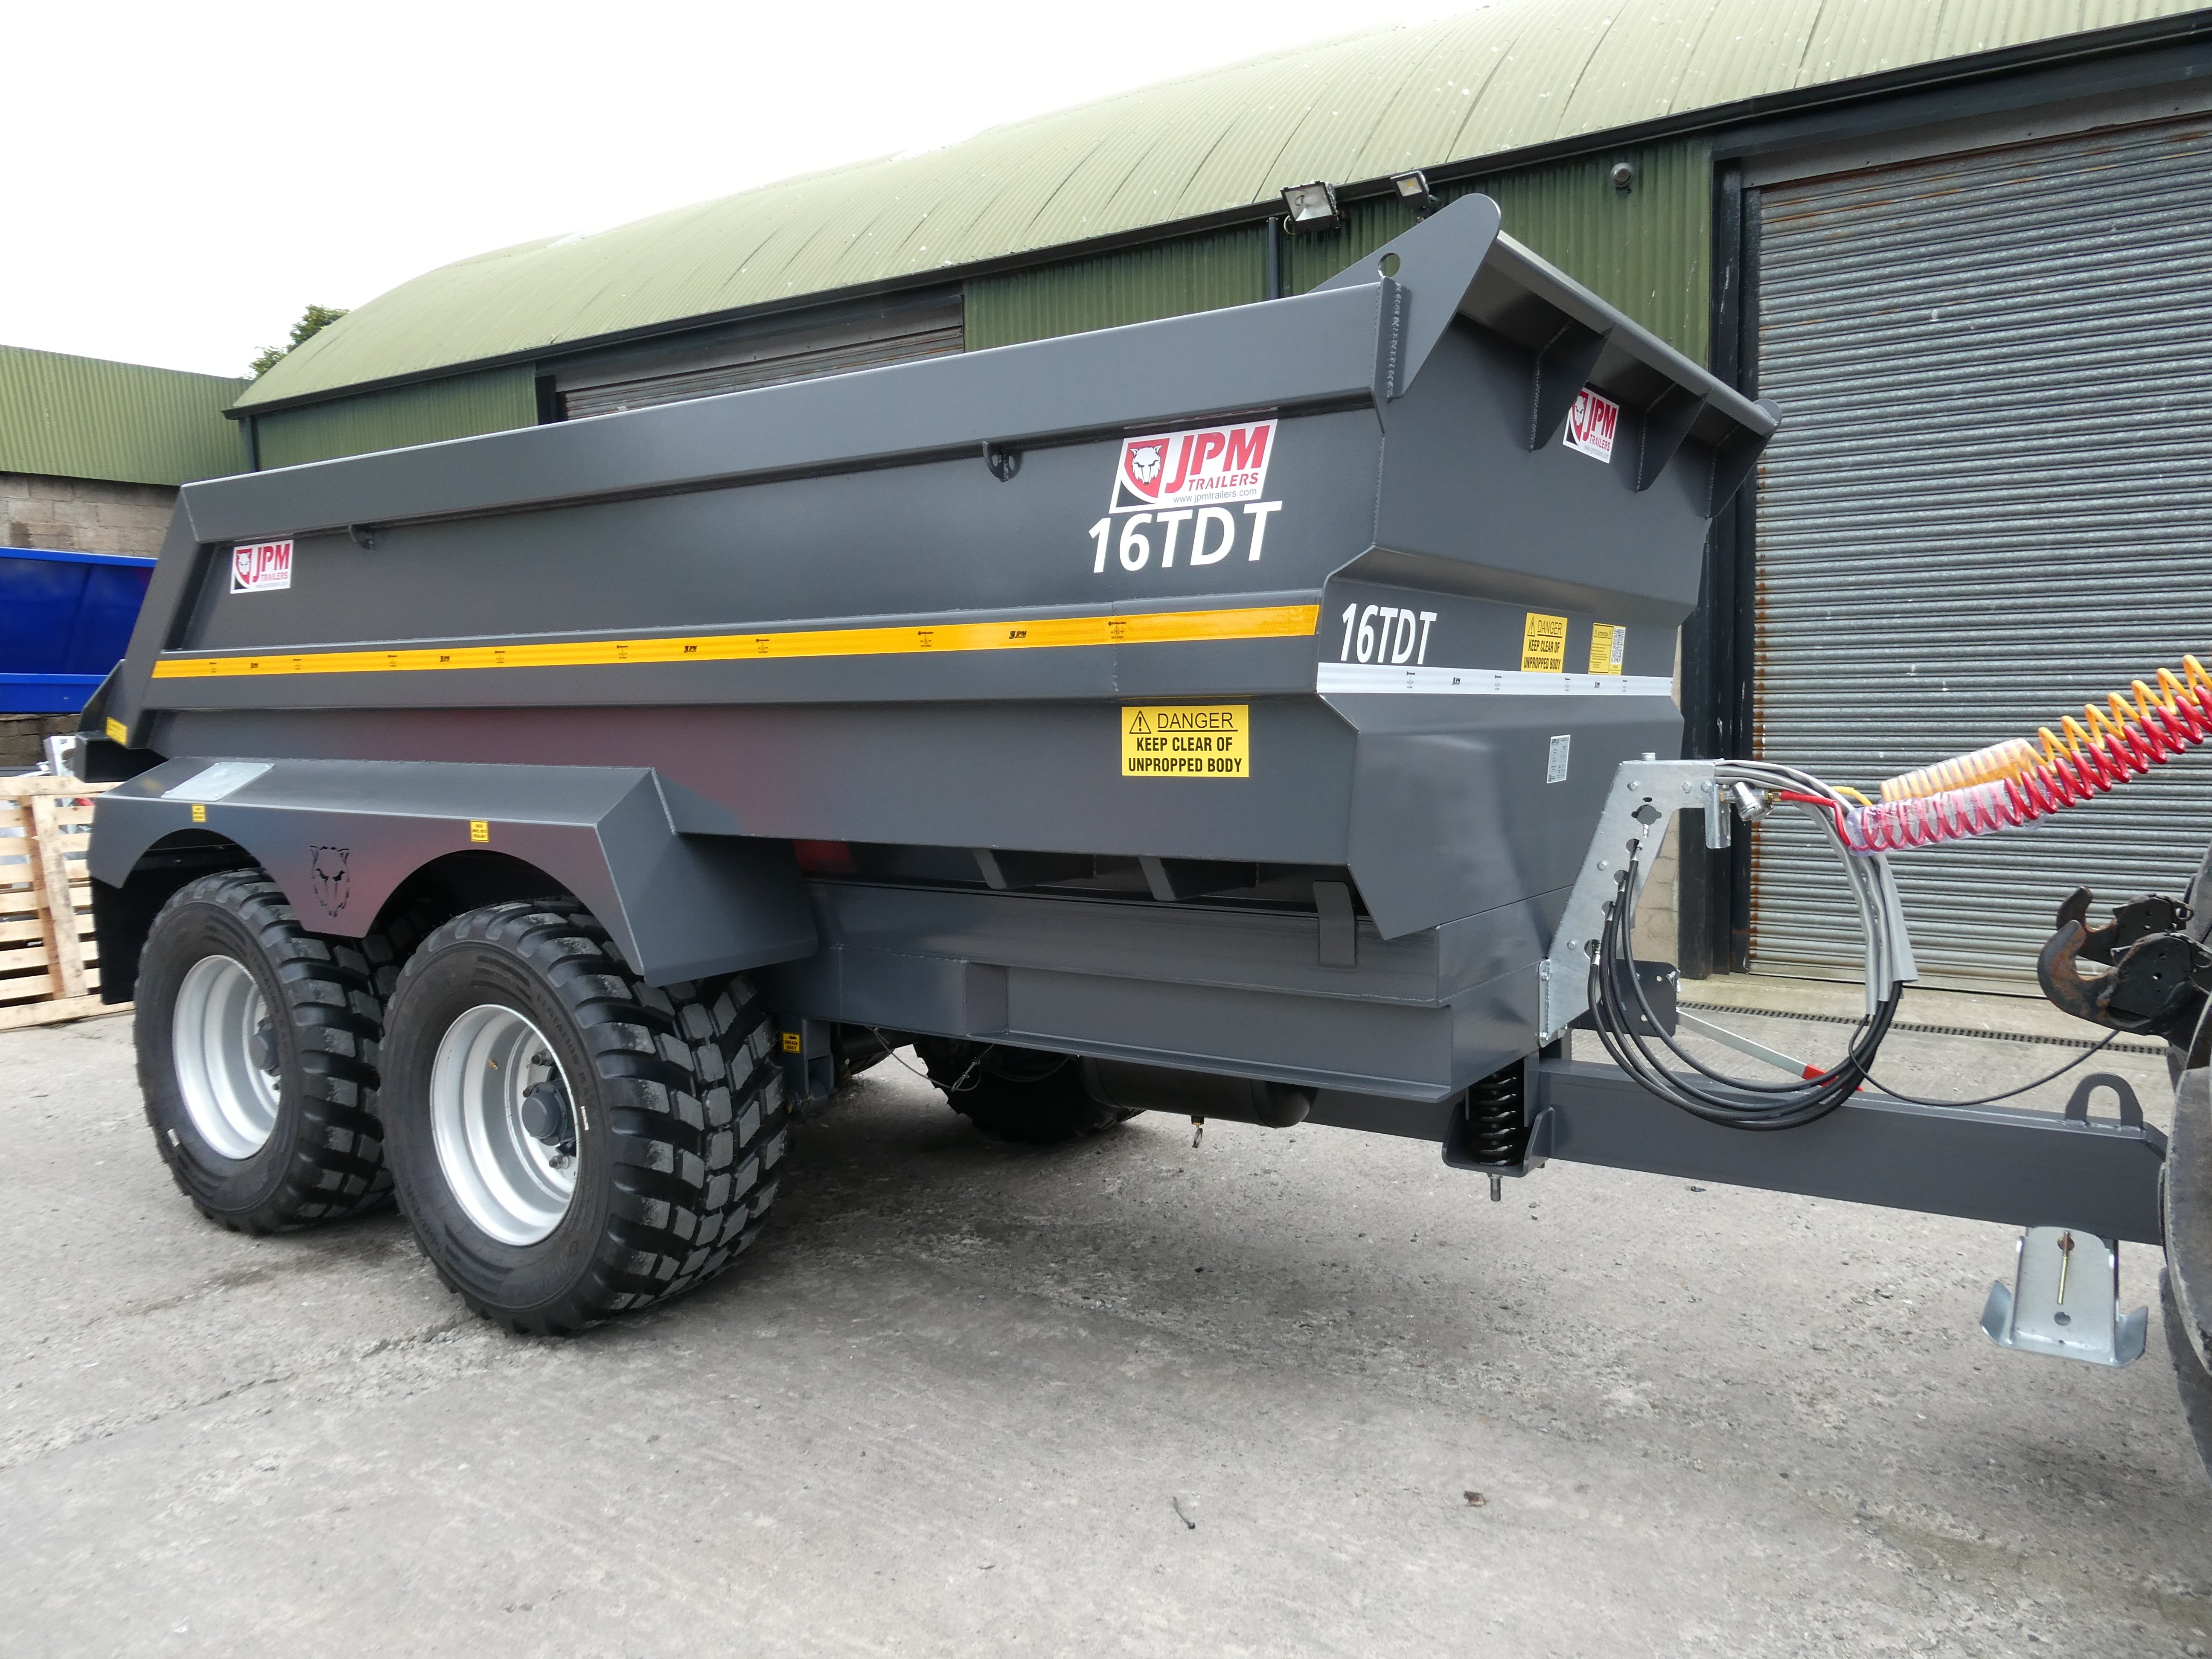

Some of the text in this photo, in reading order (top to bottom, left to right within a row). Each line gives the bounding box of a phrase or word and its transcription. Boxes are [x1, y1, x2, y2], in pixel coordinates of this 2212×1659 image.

[1583, 397, 1617, 442] JPM
[1589, 434, 1611, 451] TRAILERS
[1164, 425, 1271, 494] JPM
[1188, 472, 1259, 491] TRAILERS
[1173, 488, 1257, 504] www.jpmtrailers.com
[1089, 500, 1283, 573] 16TDT
[252, 543, 291, 582] JPM
[261, 572, 288, 582] TRAILERS
[1340, 602, 1438, 665] 16TDT
[1537, 620, 1562, 635] DANGER
[1528, 639, 1560, 653] KEEP CLEAR OF
[1523, 656, 1561, 670] UNPROPPED BODY
[1158, 712, 1234, 729] DANGER
[1136, 737, 1233, 751] KEEP CLEAR OF
[1128, 757, 1242, 772] UNPROPPED BODY
